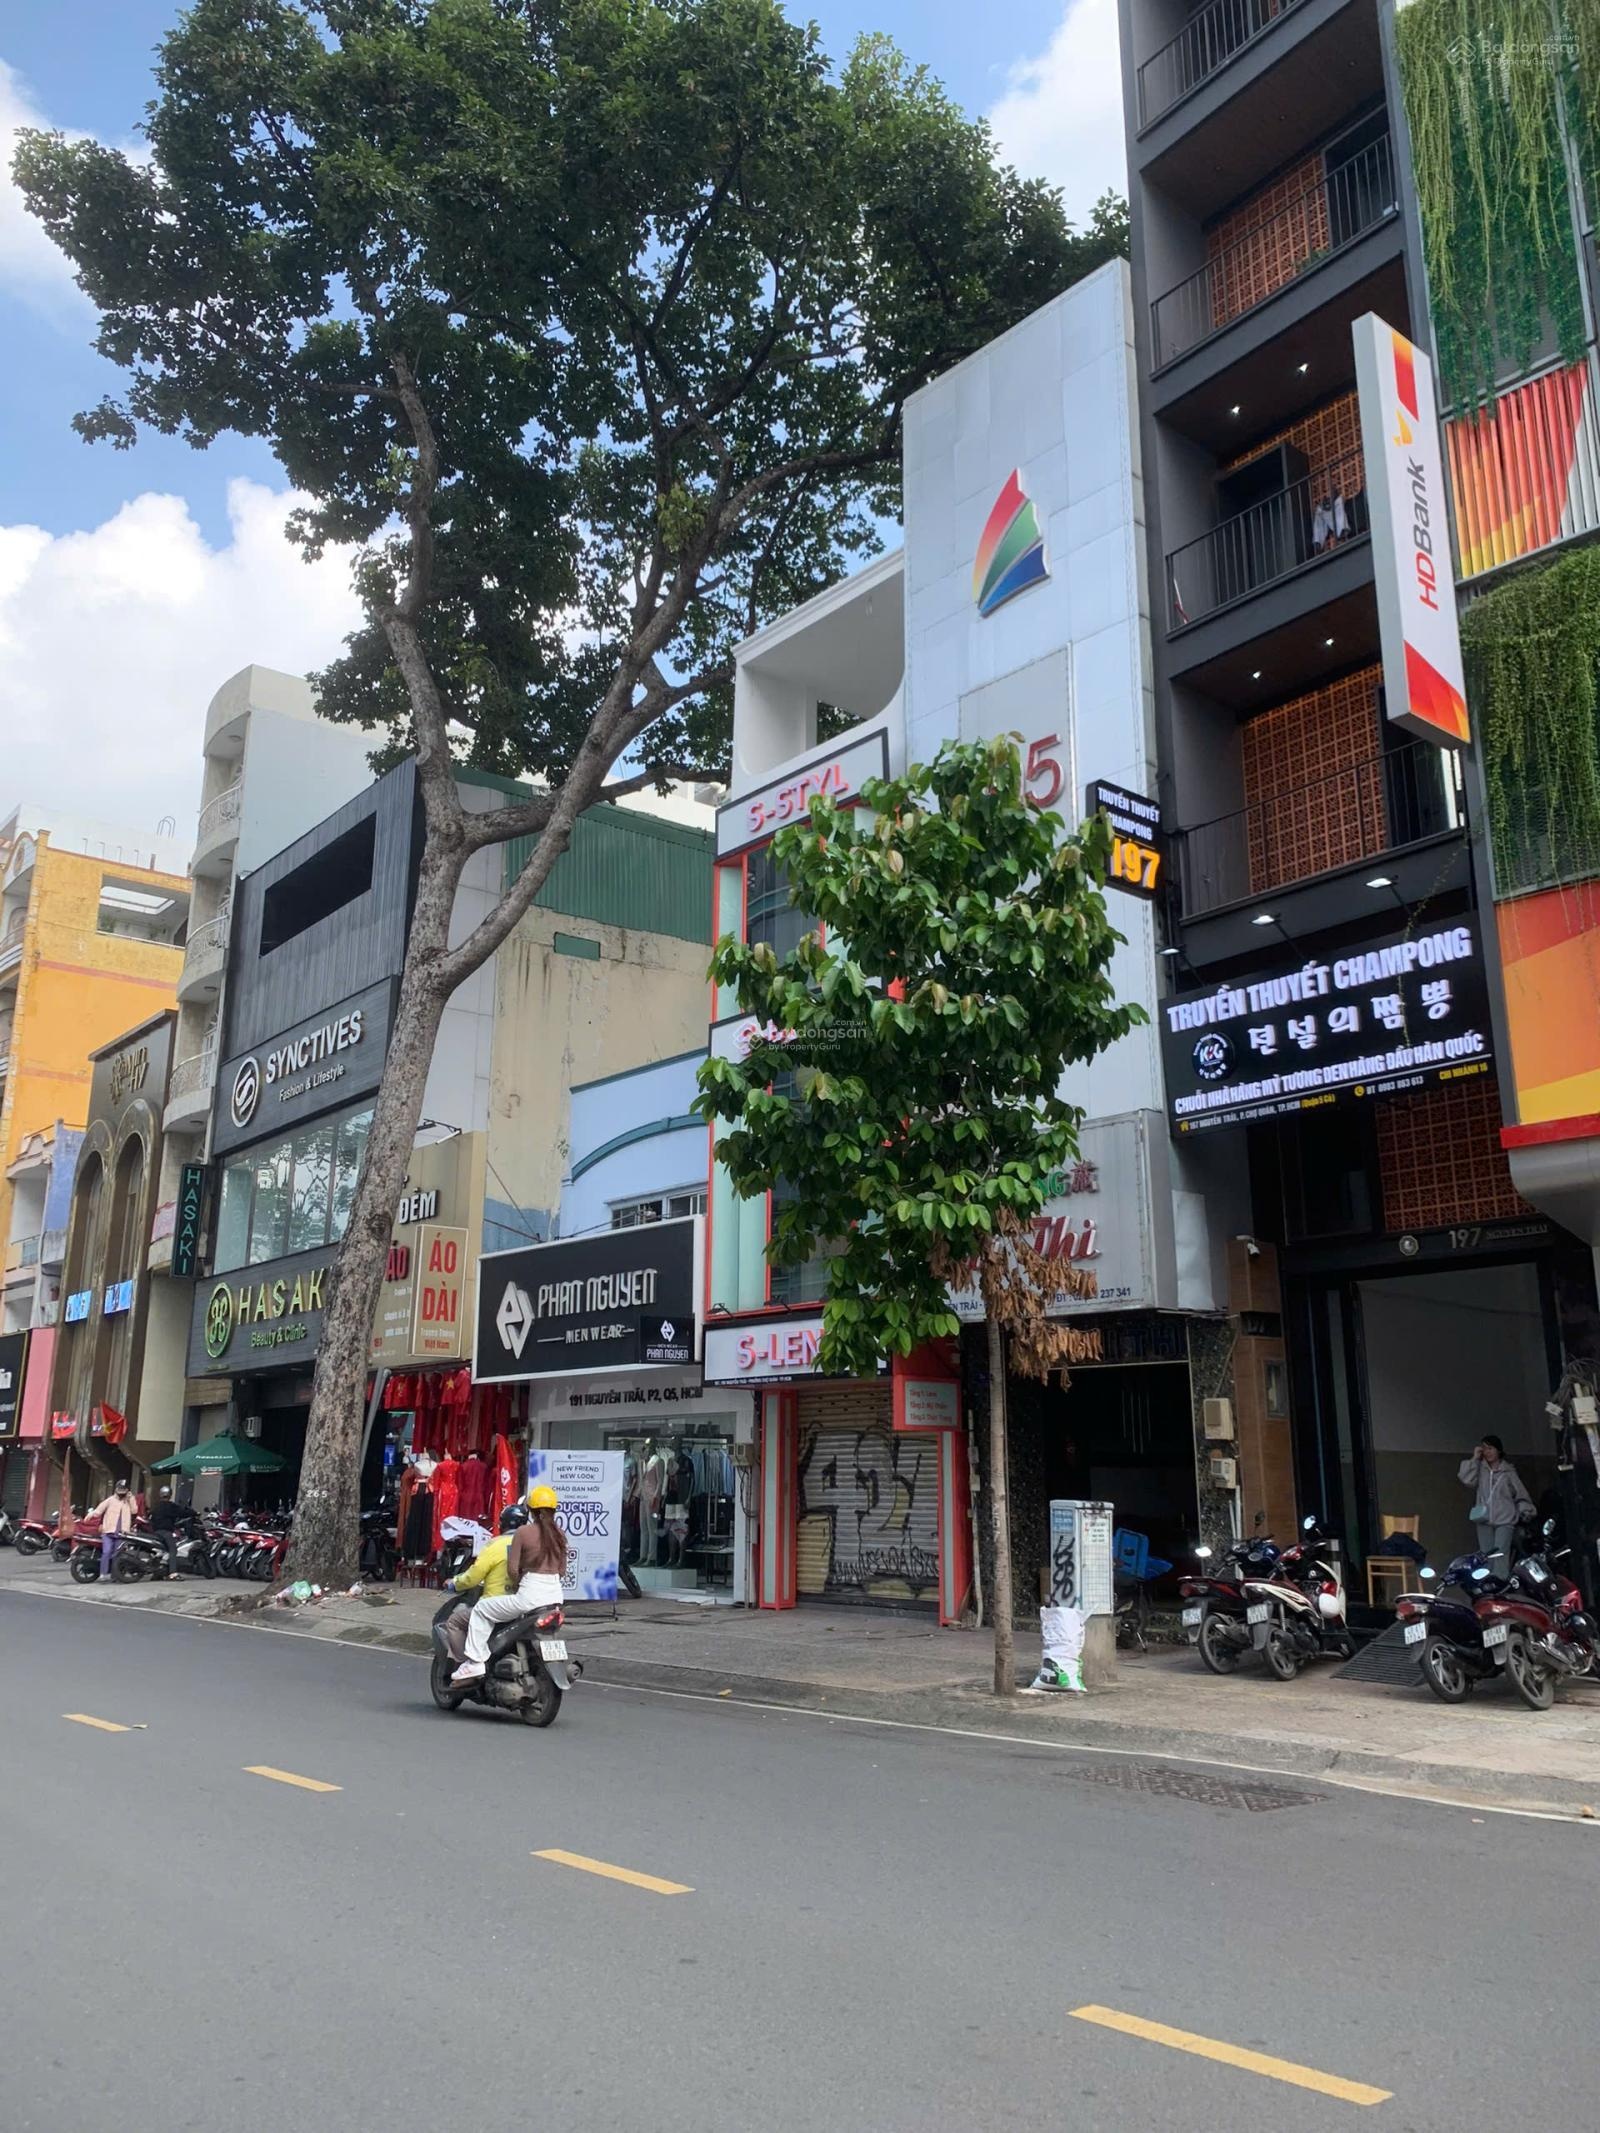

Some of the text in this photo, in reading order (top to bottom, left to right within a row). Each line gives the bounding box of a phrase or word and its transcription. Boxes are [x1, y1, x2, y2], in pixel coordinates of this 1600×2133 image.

[1407, 456, 1440, 612] HDBank
[1023, 733, 1065, 808] 5
[1110, 838, 1161, 889] 197
[1167, 927, 1473, 1033] TRUYỀN THUYẾT CHAMPONG
[266, 1010, 362, 1084] SYNCTIVES
[1445, 1029, 1484, 1058] QUỐC
[280, 1064, 345, 1102] Fashion & Lifestyle
[179, 1168, 201, 1275] HASAKI
[1449, 1227, 1482, 1249] 197
[429, 1232, 458, 1274] ÁO
[238, 1266, 332, 1326] HASAK
[421, 1281, 458, 1323] DÀI
[537, 1267, 658, 1318] PHAN NGUYEN
[1100, 1289, 1116, 1299] 237
[1116, 1287, 1131, 1298] 341
[251, 1328, 277, 1348] Beauty
[284, 1322, 308, 1341] Clinic
[565, 1324, 623, 1344] MEN WEAR
[646, 1348, 689, 1359] PHAN NGUYEN
[569, 1394, 583, 1406] 191
[648, 1388, 662, 1403] P2,
[663, 1388, 679, 1402] Q5,
[681, 1386, 703, 1399] HCM
[306, 1489, 328, 1498] 265
[557, 1502, 603, 1512] OUCHER
[555, 1511, 609, 1536] 00K
